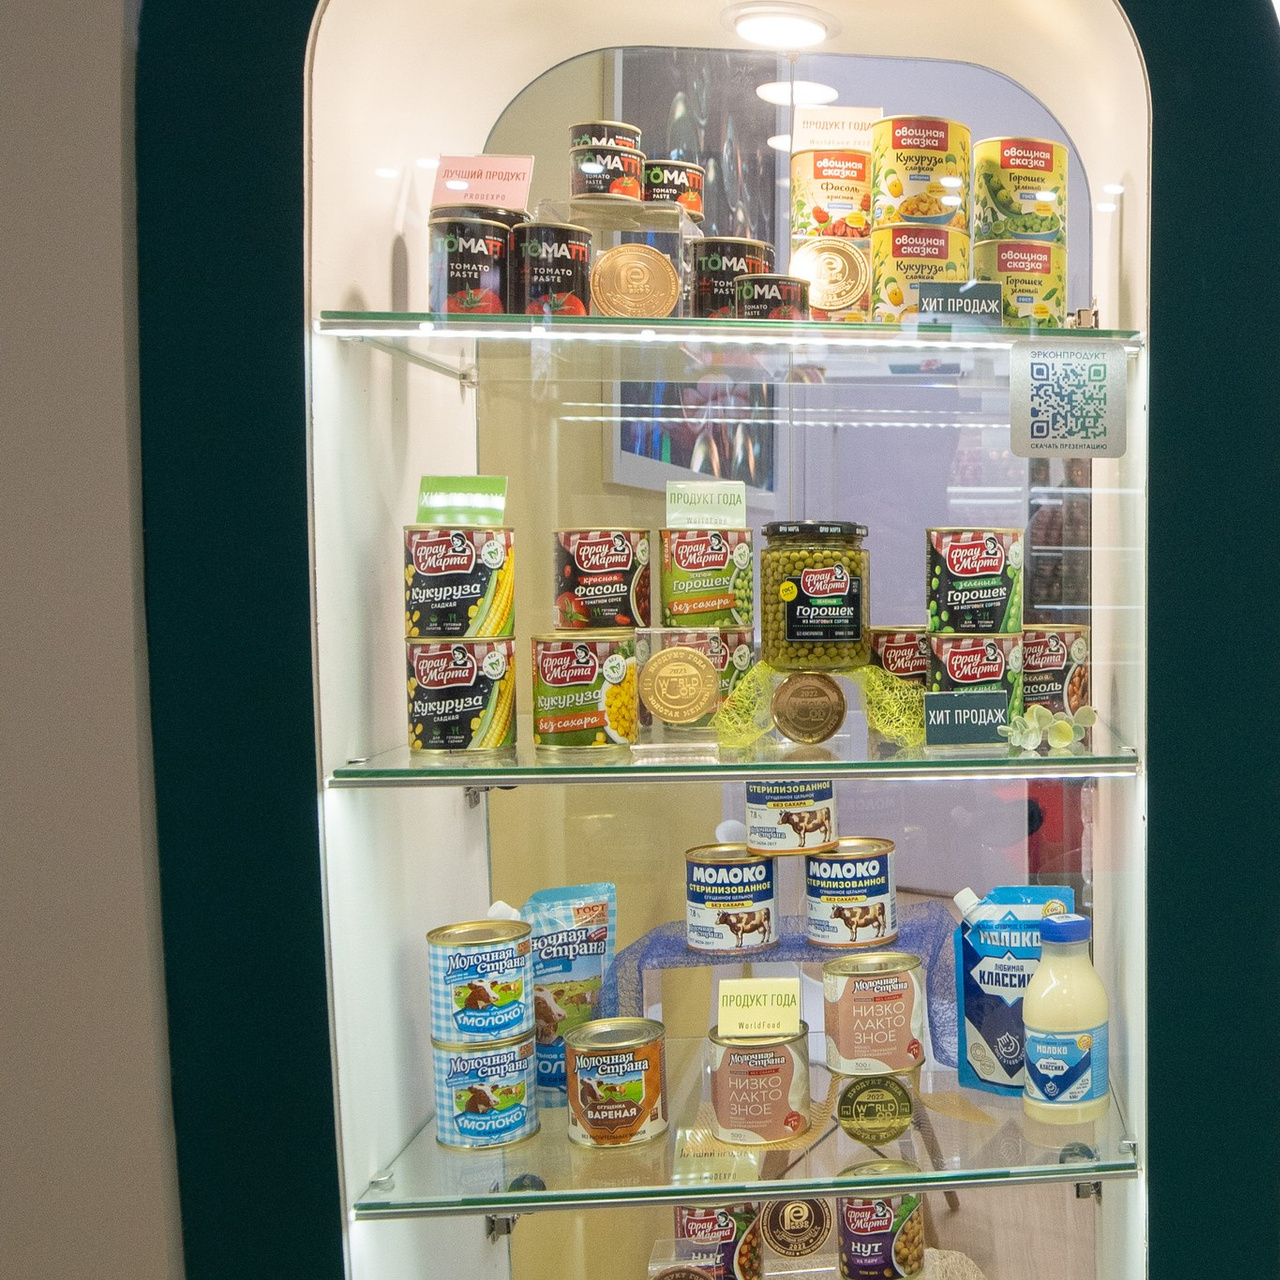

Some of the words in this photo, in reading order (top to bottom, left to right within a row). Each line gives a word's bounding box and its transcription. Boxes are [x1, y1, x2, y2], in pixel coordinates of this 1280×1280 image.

[803, 121, 844, 130] ПРОДУКТ
[849, 121, 872, 131] ГОДА
[901, 137, 939, 148] сказка
[896, 152, 944, 166] Кукуруза
[1010, 157, 1045, 168] сказка
[442, 169, 482, 180] ЛУЧШИЙ
[486, 170, 526, 182] ПРОДУКТ
[822, 169, 857, 178] сказка
[1009, 173, 1045, 183] Горошек
[821, 182, 860, 193] Фасоль
[521, 240, 588, 262] TOMATTI
[901, 245, 939, 256] сказка
[450, 263, 490, 272] TOMATO
[533, 267, 572, 276] TOMATO
[896, 261, 944, 276] Кукуруза
[1006, 260, 1042, 271] сказка
[450, 271, 478, 279] PASTE
[1006, 276, 1043, 289] Горошек
[921, 297, 943, 313] ХИТ
[948, 297, 999, 315] ПРОДАЖ
[1031, 351, 1107, 360] ЭРКОНПРОДУКТ
[669, 493, 713, 505] ПРОДУКТ
[717, 493, 742, 505] ГОДА
[421, 554, 468, 571] Марта
[584, 554, 627, 568] Марта
[682, 553, 724, 569] Марта
[955, 558, 999, 573] Марта
[574, 584, 628, 597] Фасоль
[673, 575, 731, 593] Горошек
[809, 581, 844, 593] Марта
[411, 583, 481, 603] Кукуруза
[947, 587, 1006, 603] Горошек
[672, 602, 690, 613] без
[692, 597, 730, 611] сахара
[796, 606, 854, 618] Горошек
[422, 669, 469, 684] Марта
[546, 667, 591, 681] Марта
[957, 664, 999, 679] Марта
[414, 695, 483, 716] Кукуруза
[537, 690, 602, 708] Кукуруза
[539, 720, 556, 732] без
[557, 715, 599, 729] сахара
[929, 709, 951, 725] ХИТ
[954, 708, 1006, 725] ПРОДАЖ
[749, 781, 830, 794] СТЕРИЛИЗОВАННОЕ
[693, 864, 767, 884] МОЛОКО
[809, 860, 880, 878] МОЛОКО
[689, 881, 771, 894] СТЕРИЛИЗОВАННОЕ
[807, 876, 885, 889] СТЕРИЛИЗОВАННОЕ
[577, 904, 606, 914] ГОСТ
[979, 931, 1041, 948] МОЛОКО
[540, 940, 605, 959] Страна
[447, 948, 513, 975] Молочная
[477, 955, 525, 974] Страна
[994, 963, 1024, 972] ЛЮБИМАЯ
[852, 977, 899, 993] Молочная
[722, 994, 767, 1008] ПРОДУКТ
[771, 994, 797, 1007] ГОДА
[852, 1001, 905, 1017] НИЗКО
[462, 1007, 521, 1027] МОЛОКО
[854, 1015, 906, 1031] ЛАКТО
[738, 1021, 781, 1030] WorldFood
[854, 1029, 897, 1044] ЗНОЕ
[1036, 1044, 1068, 1055] МОЛОКО
[449, 1052, 515, 1078] Молочная
[575, 1052, 633, 1073] Молочная
[729, 1052, 775, 1066] Молочная
[478, 1059, 528, 1077] Страна
[598, 1059, 649, 1076] Страна
[1039, 1063, 1065, 1072] КЛАССИКА
[728, 1076, 782, 1089] НИЗКО
[729, 1089, 782, 1103] ЛАКТО
[588, 1108, 637, 1119] ВАРЕНАЯ
[730, 1103, 772, 1116] ЗНОЕ
[463, 1111, 522, 1130] МОЛОКО
[851, 1218, 888, 1231] Марта
